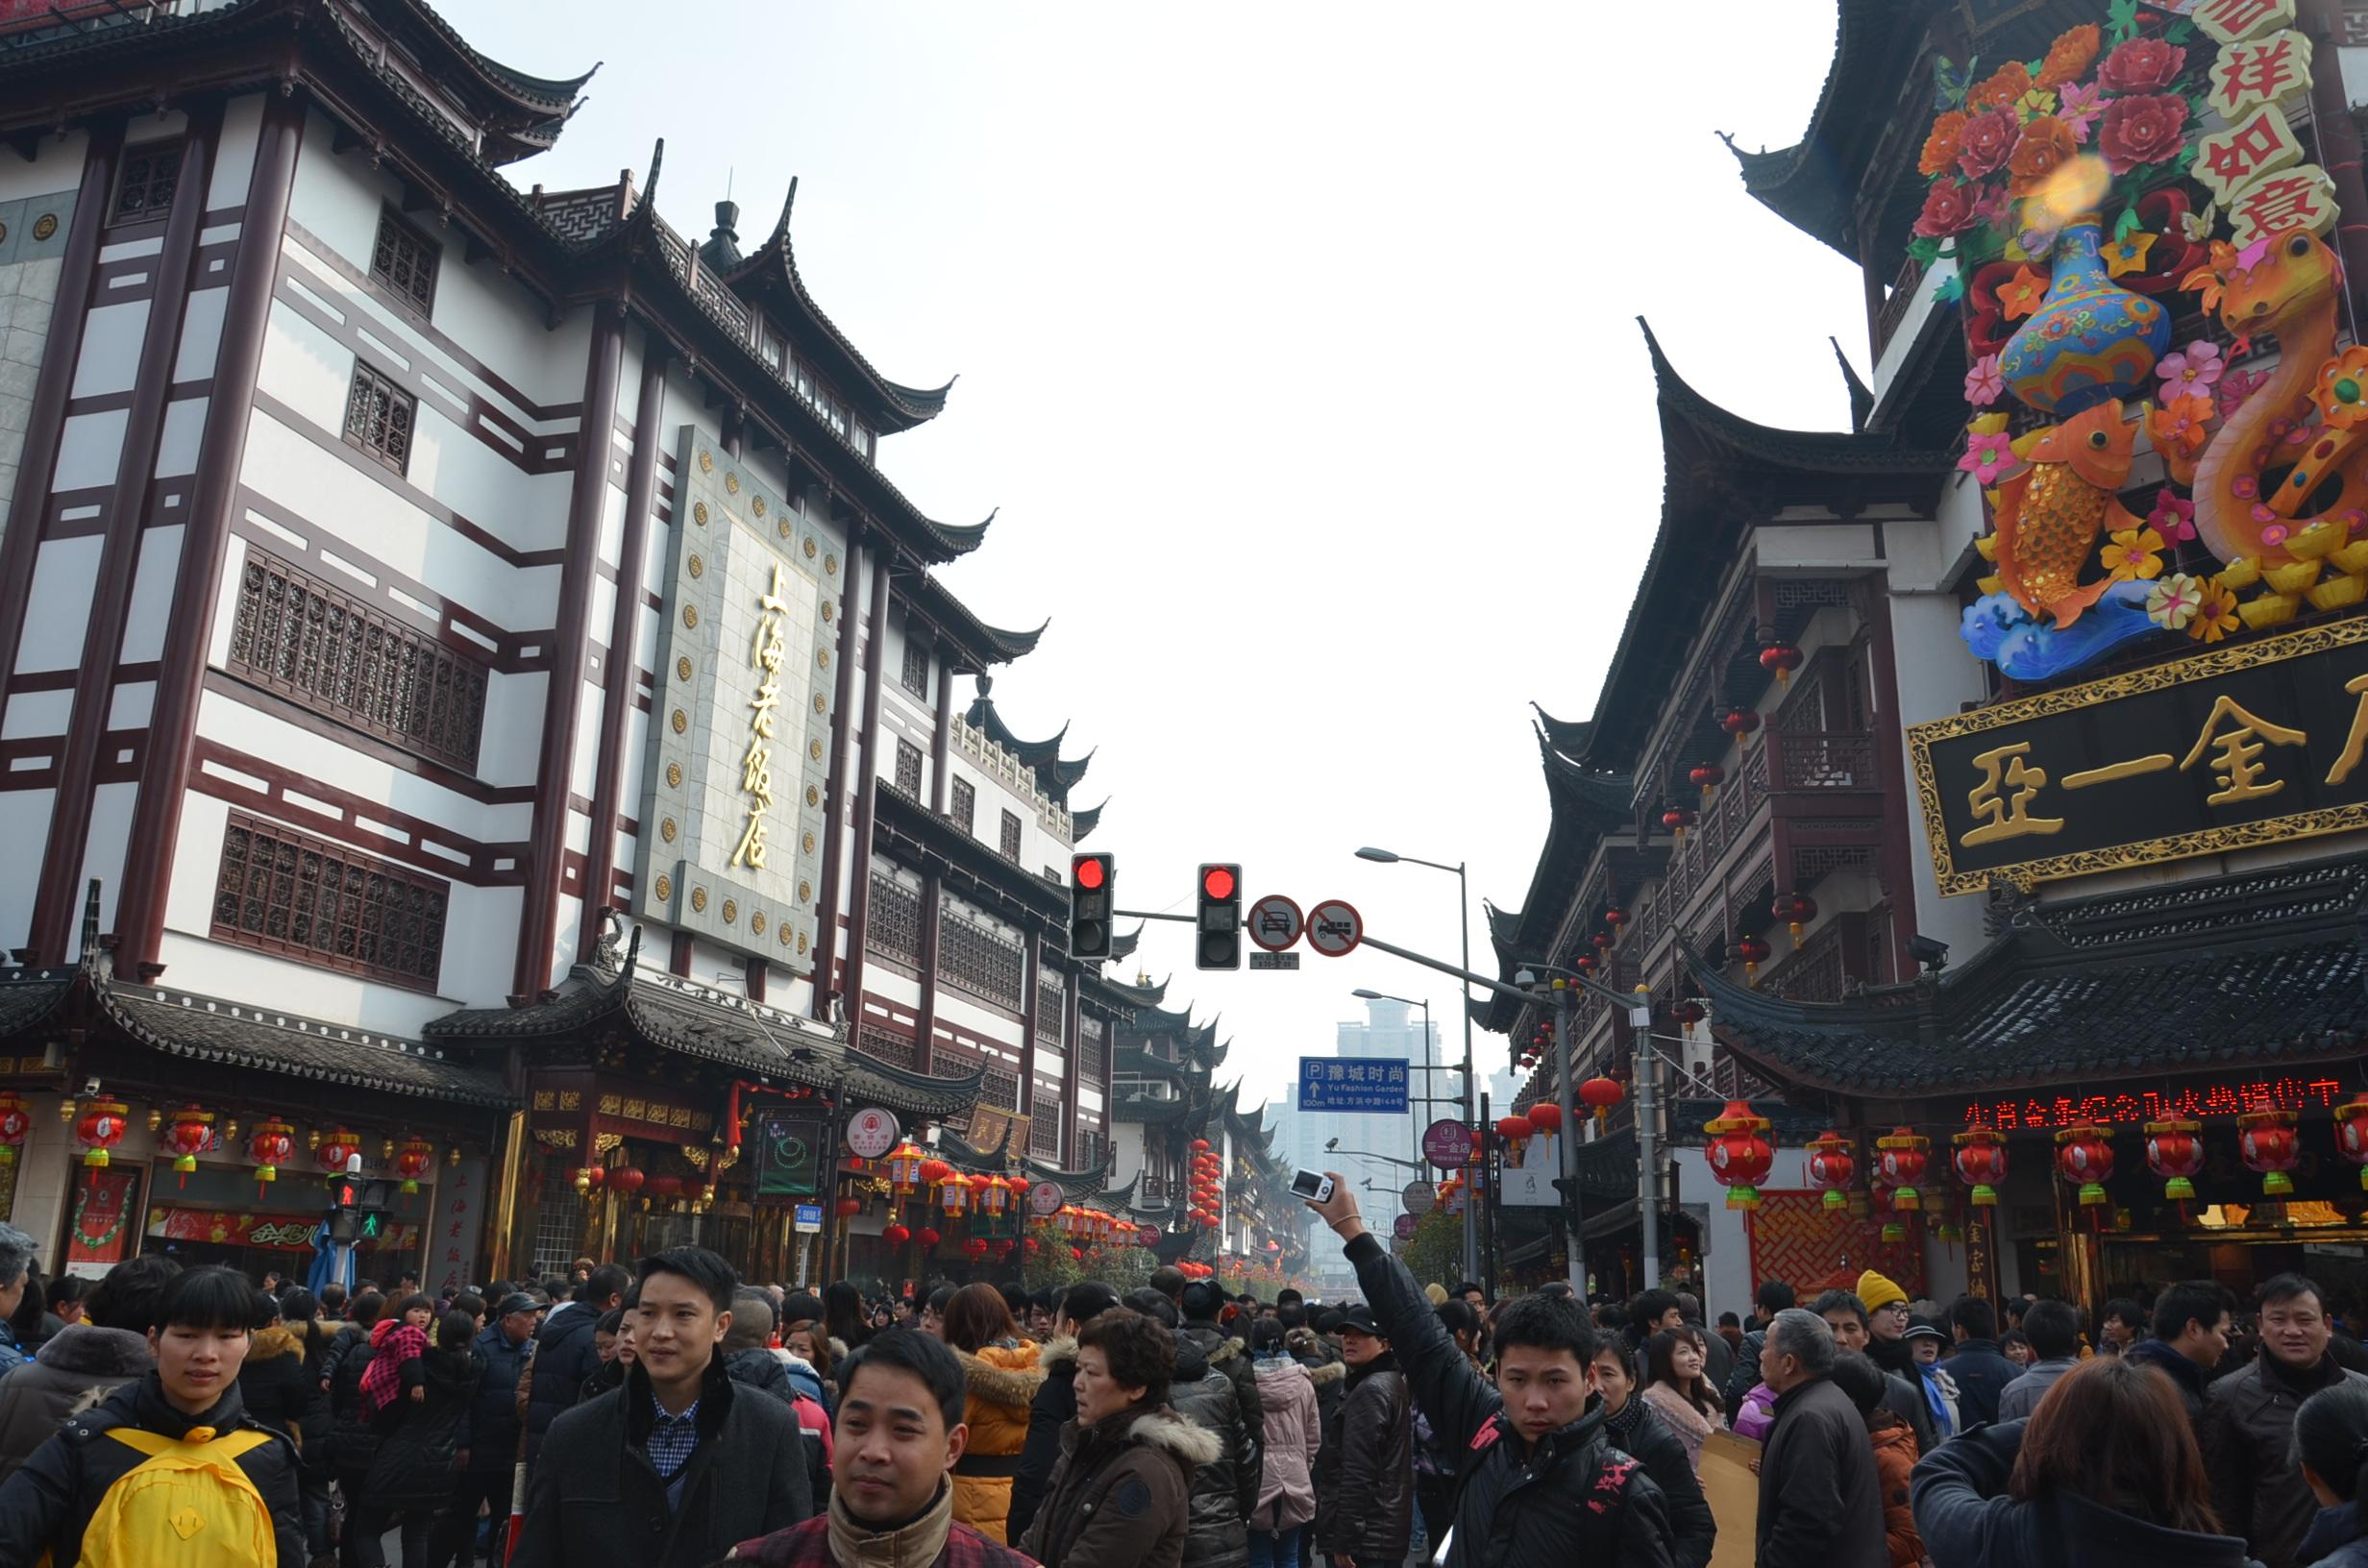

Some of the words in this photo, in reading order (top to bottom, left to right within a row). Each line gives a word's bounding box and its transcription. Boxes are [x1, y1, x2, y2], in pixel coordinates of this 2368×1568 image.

[1310, 1065, 1320, 1076] P
[1328, 1065, 1403, 1082] 豫城时尚
[1341, 1084, 1373, 1092] Fashion
[1374, 1085, 1404, 1093] Garden
[1303, 1098, 1325, 1107] 100m
[1425, 1141, 1470, 1154] 亚一金店
